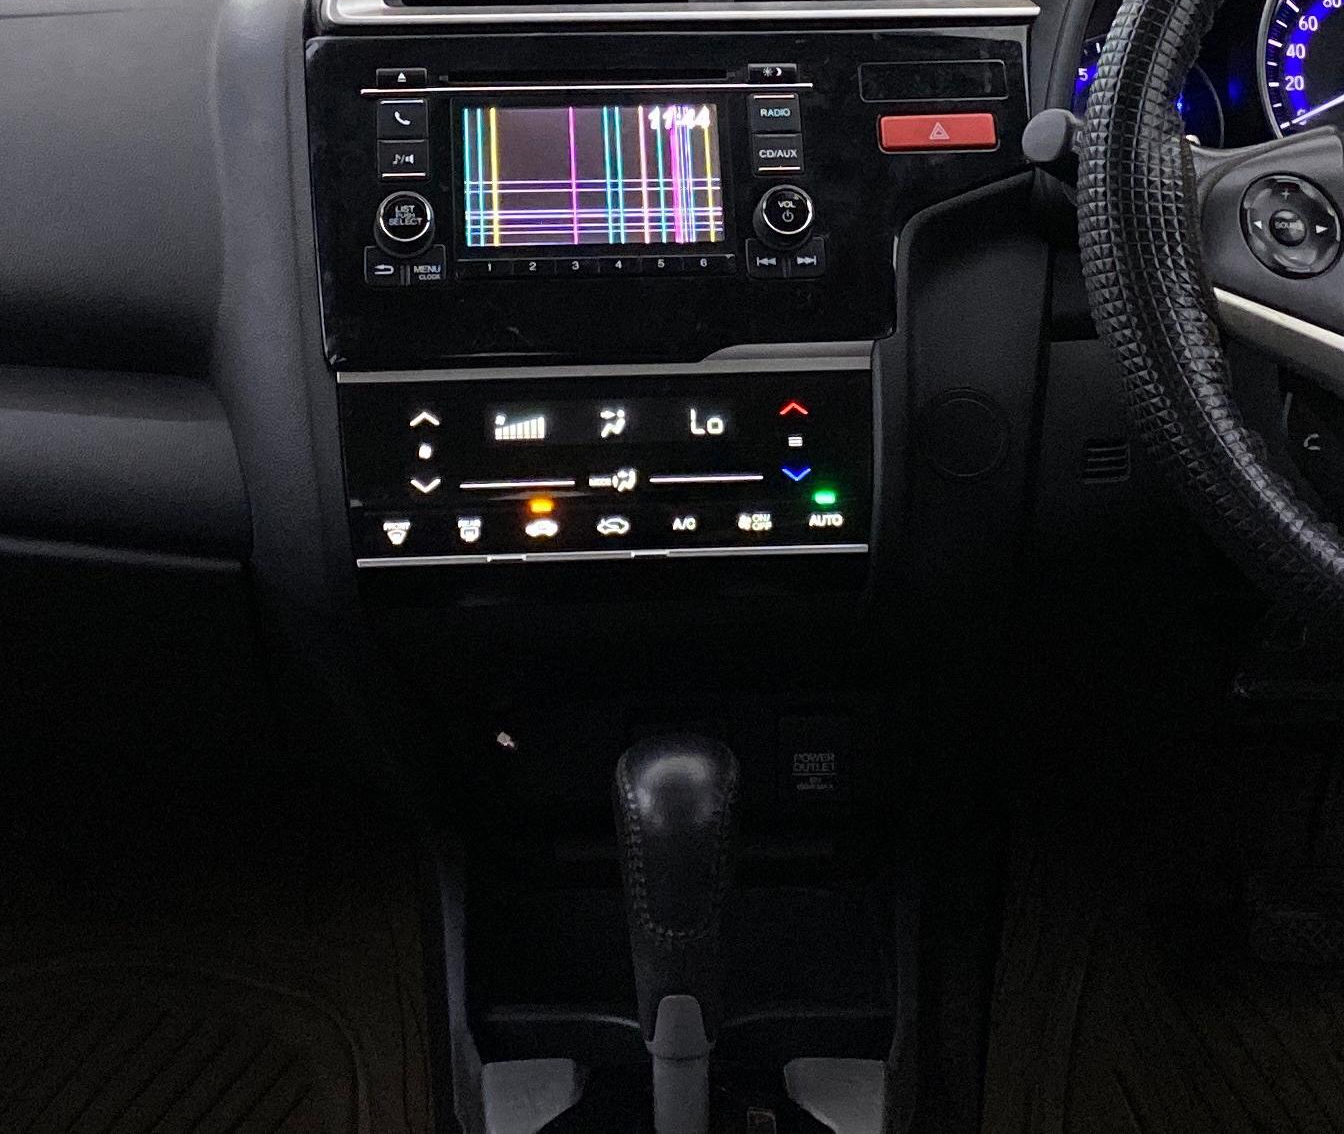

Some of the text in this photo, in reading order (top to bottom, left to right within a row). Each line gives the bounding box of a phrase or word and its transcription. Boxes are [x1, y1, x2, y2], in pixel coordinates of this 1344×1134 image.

[1298, 16, 1318, 31] 60
[1286, 44, 1306, 59] 40
[1078, 68, 1088, 81] 5
[1284, 75, 1305, 91] 20
[760, 108, 791, 117] RADIO
[759, 149, 798, 159] CD/AUX
[395, 204, 416, 213] LIST
[777, 200, 797, 209] VOL
[388, 217, 423, 226] SELECT
[413, 264, 441, 274] MENU
[487, 258, 708, 272] 1 2 3 4 5 6
[689, 408, 724, 435] Lo
[752, 513, 770, 522] ON/
[809, 514, 844, 528] AUTO
[672, 517, 697, 531] A/C
[752, 521, 772, 531] OFF
